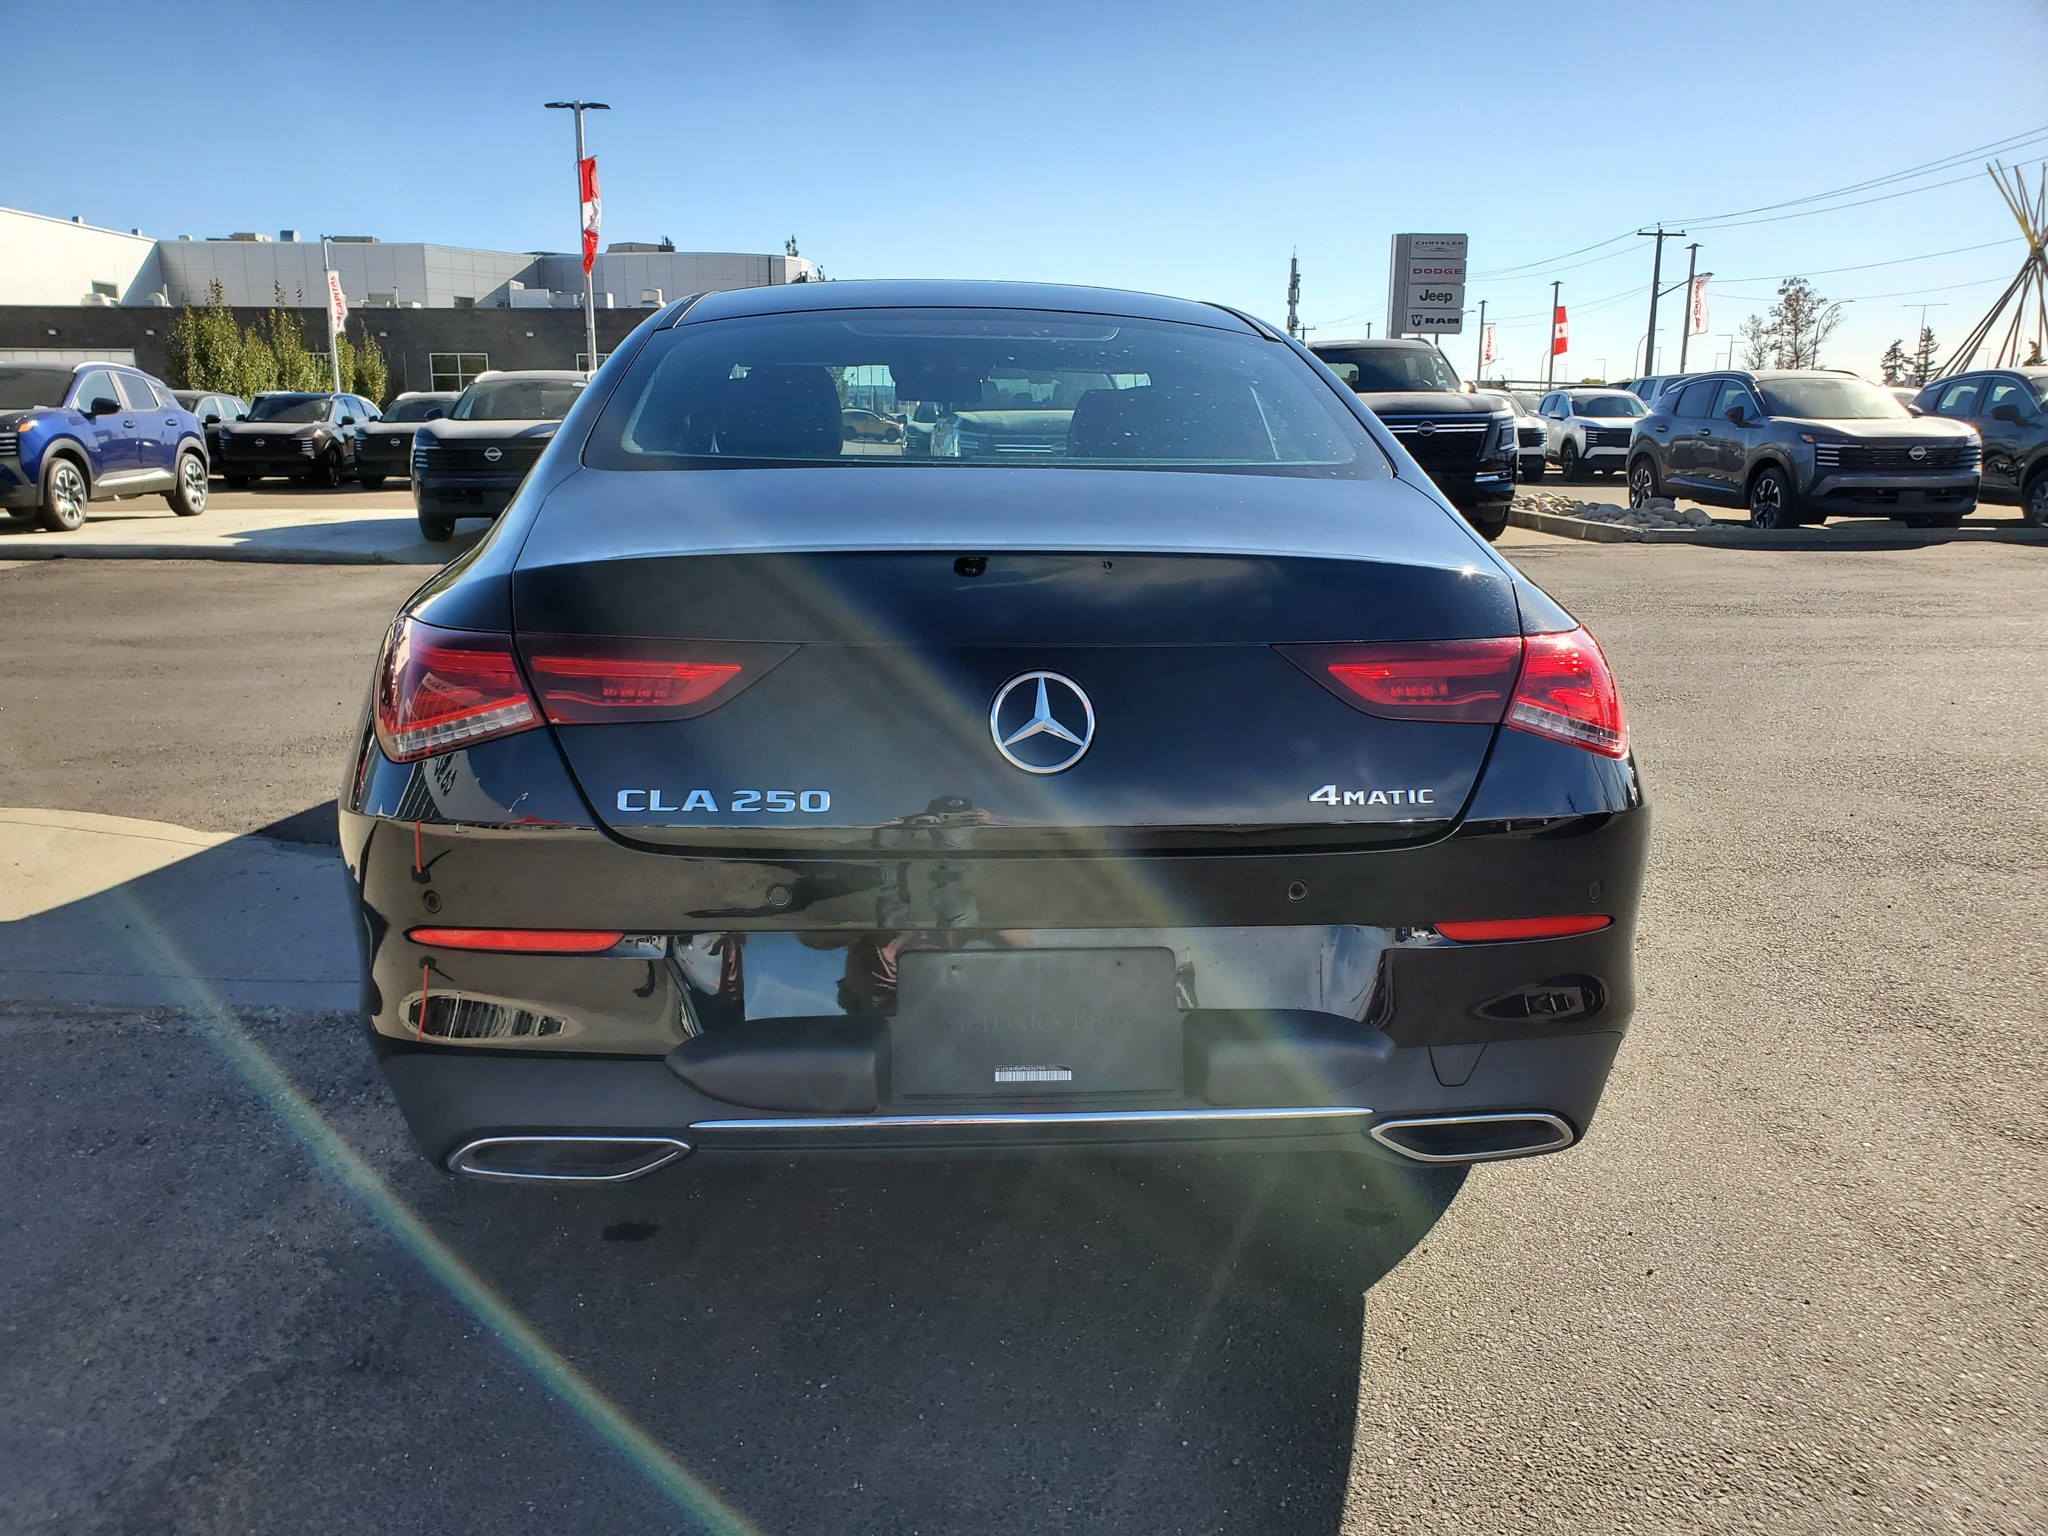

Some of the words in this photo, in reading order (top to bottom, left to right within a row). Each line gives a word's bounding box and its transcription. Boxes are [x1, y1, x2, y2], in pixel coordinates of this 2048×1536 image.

[1419, 289, 1453, 304] Jeep
[1424, 317, 1460, 325] RAM
[616, 789, 719, 812] CLA
[731, 789, 831, 813] 250
[1307, 784, 1435, 806] 4MATIC
